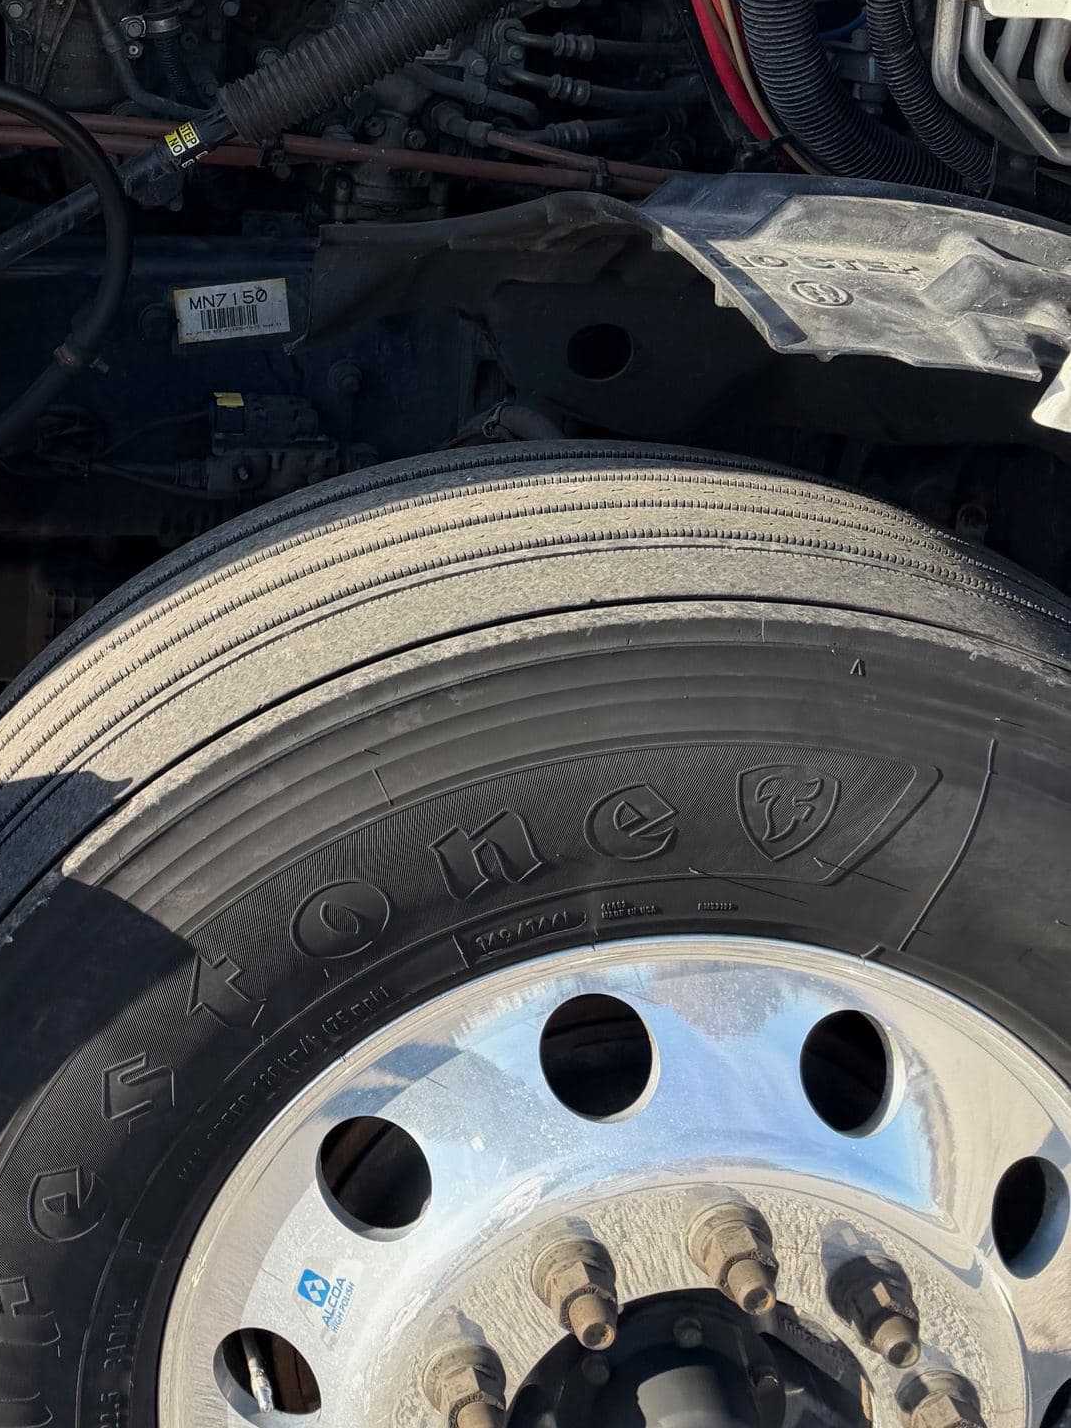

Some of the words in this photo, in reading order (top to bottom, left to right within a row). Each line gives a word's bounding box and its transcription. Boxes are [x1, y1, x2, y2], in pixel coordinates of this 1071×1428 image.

[179, 123, 198, 145] STEP
[189, 288, 269, 311] MN7150
[321, 1277, 347, 1327] ALCOA
[339, 1281, 356, 1313] POLISH
